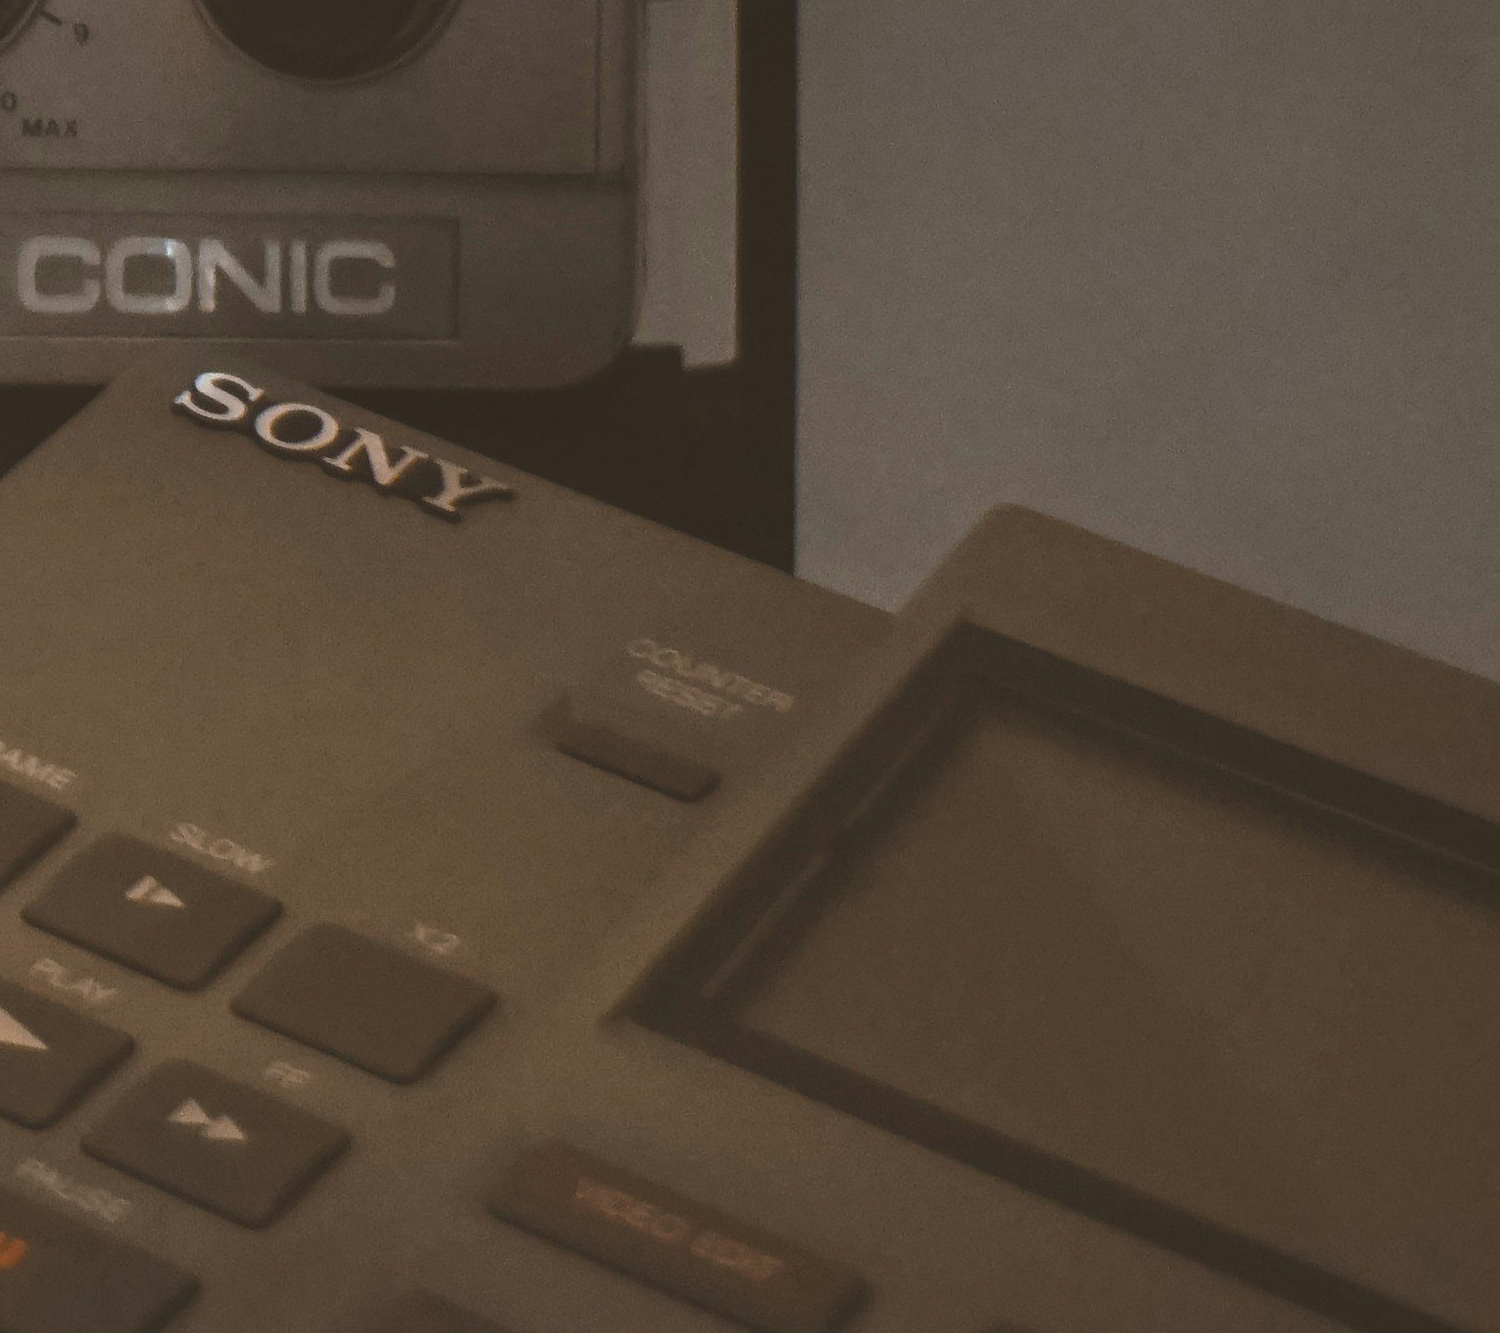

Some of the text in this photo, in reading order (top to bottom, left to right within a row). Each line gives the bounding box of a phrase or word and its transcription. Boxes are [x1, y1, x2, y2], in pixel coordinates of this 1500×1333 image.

[74, 25, 89, 45] 9
[22, 119, 78, 139] MAX
[17, 234, 397, 317] CONIC
[176, 370, 512, 521] SONY
[626, 638, 796, 714] COUNTER
[170, 822, 275, 873] SLOW
[30, 956, 118, 1002] PLAY
